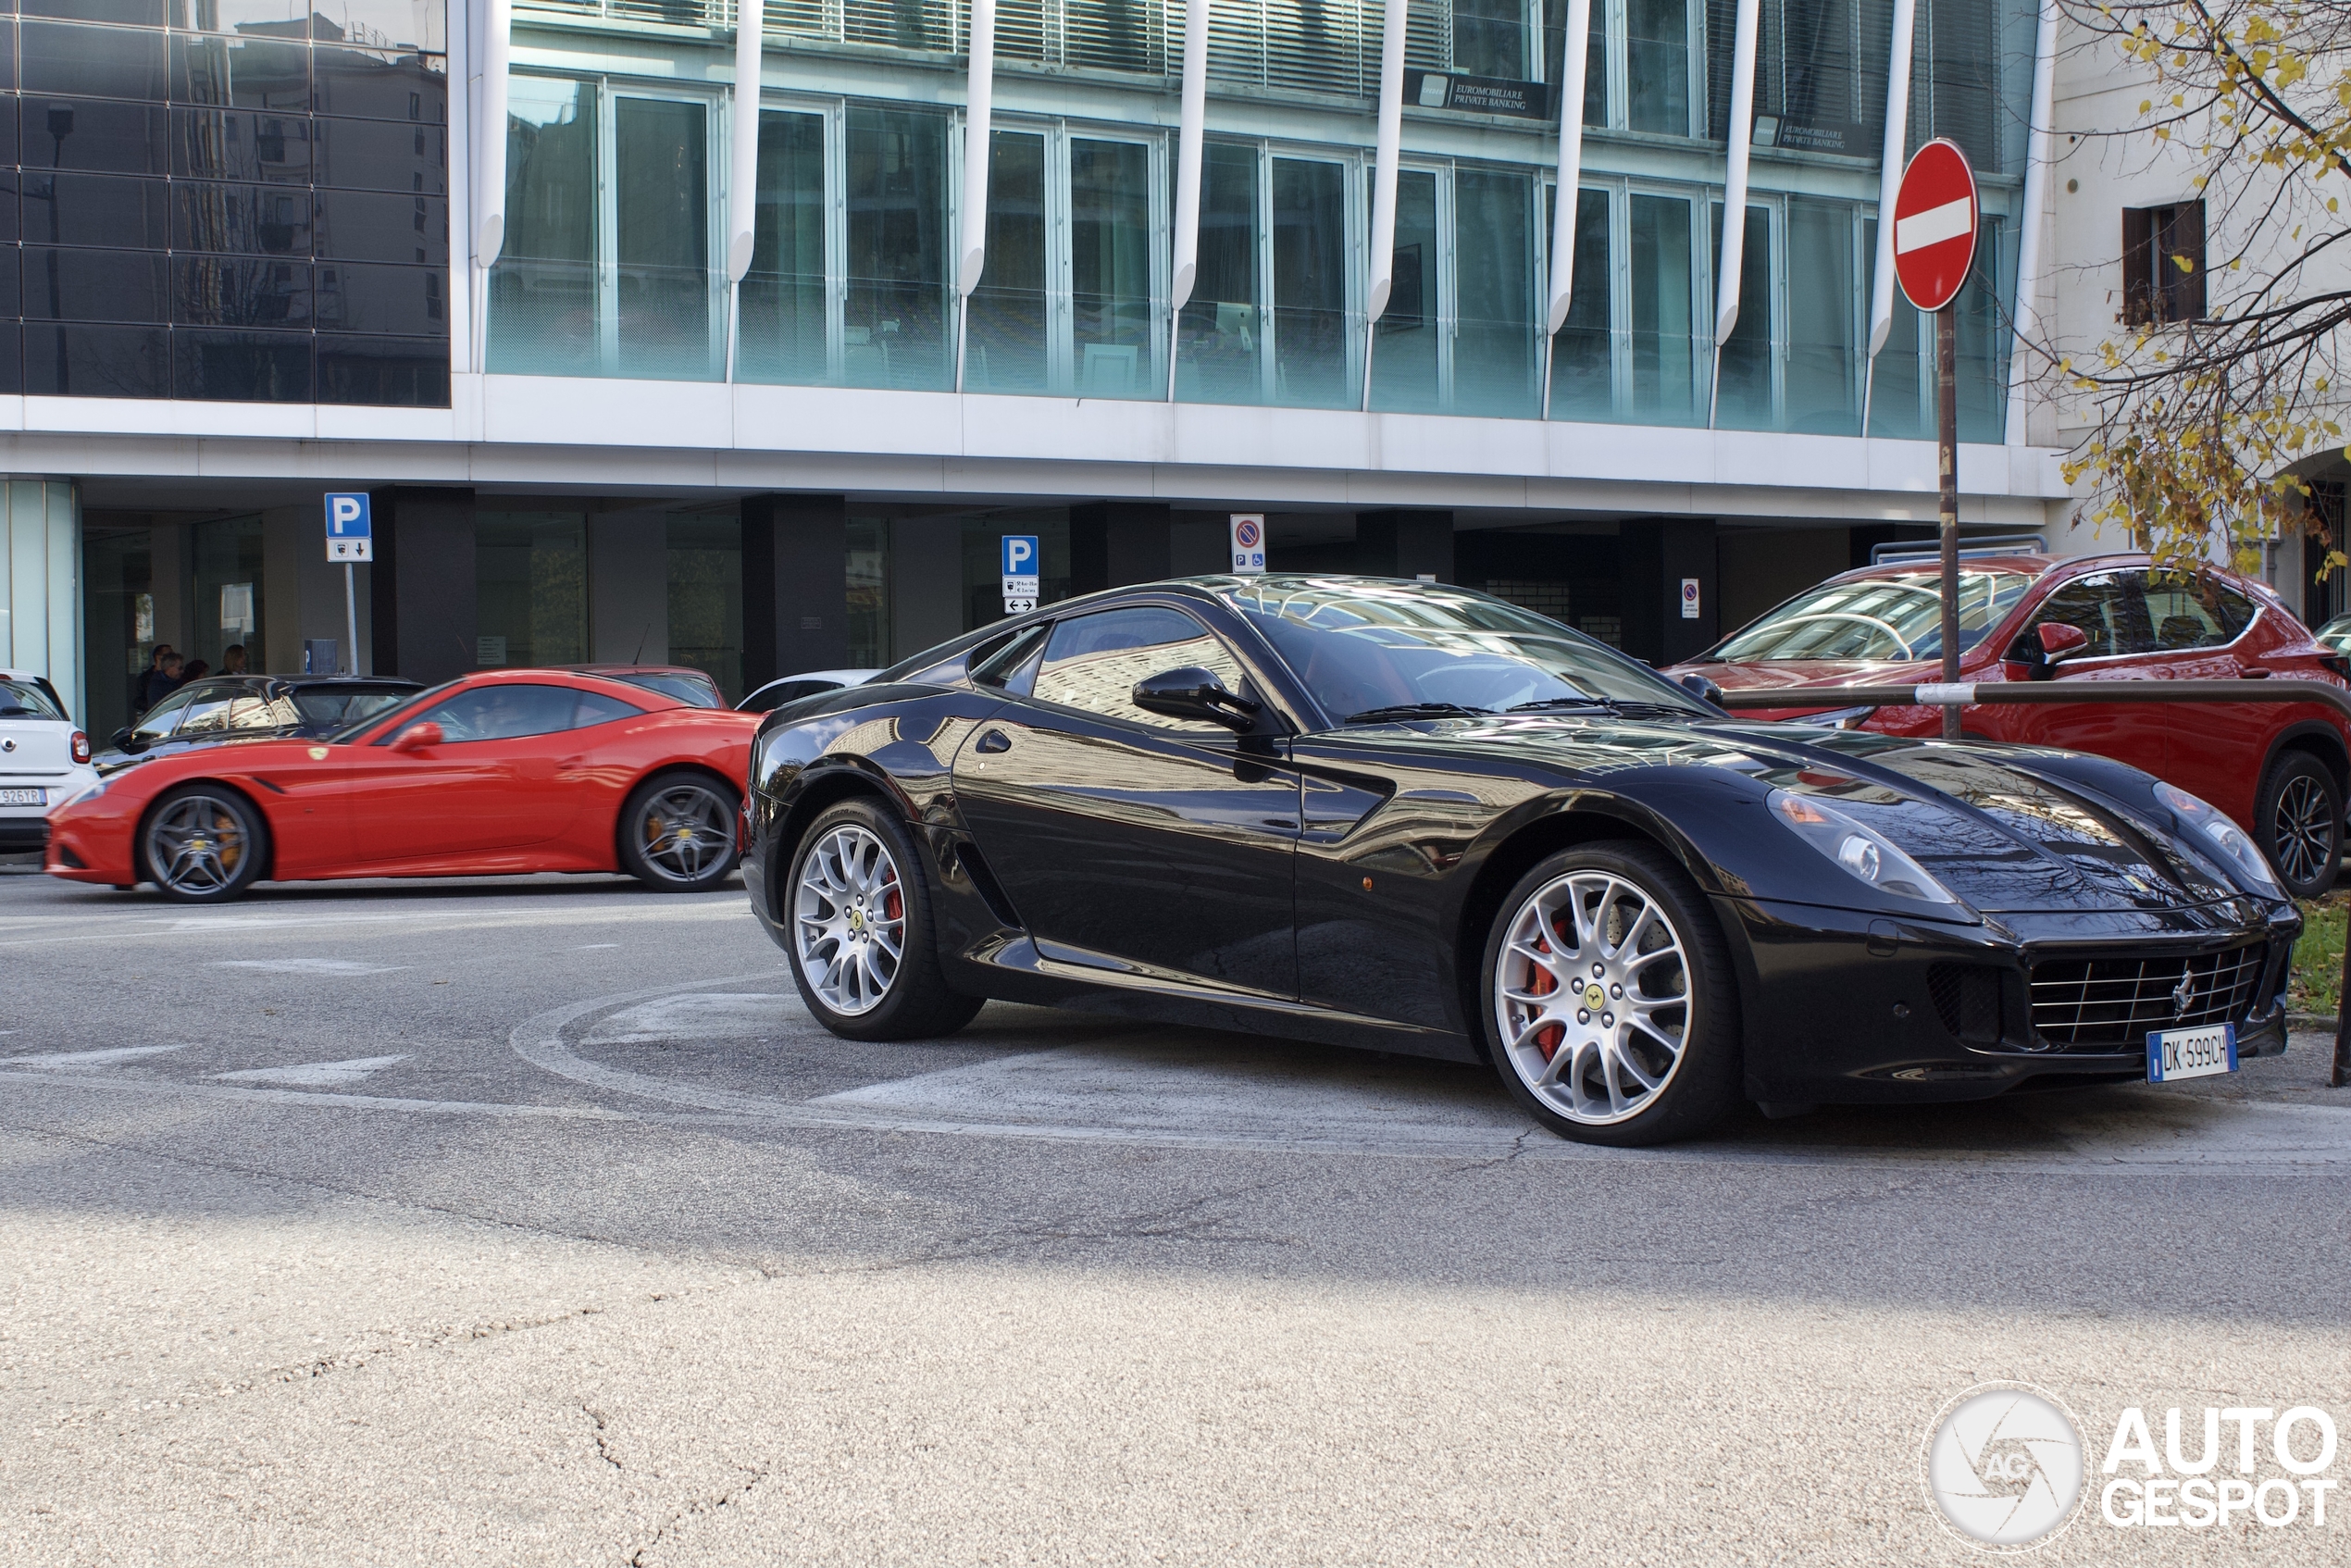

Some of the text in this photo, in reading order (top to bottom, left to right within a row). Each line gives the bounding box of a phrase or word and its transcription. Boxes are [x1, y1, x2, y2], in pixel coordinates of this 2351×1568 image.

[1457, 84, 1523, 100] EUROMOBILIARE
[1454, 93, 1526, 110] PRIVATE BANKING
[1785, 125, 1843, 140] EUROMOBILIARE
[1783, 134, 1845, 148] PRIVATE BANKING
[333, 497, 361, 534] P
[1009, 540, 1031, 572] P
[1238, 555, 1244, 565] P
[2, 790, 39, 803] 926YR
[2163, 1034, 2227, 1072] DK 599CH
